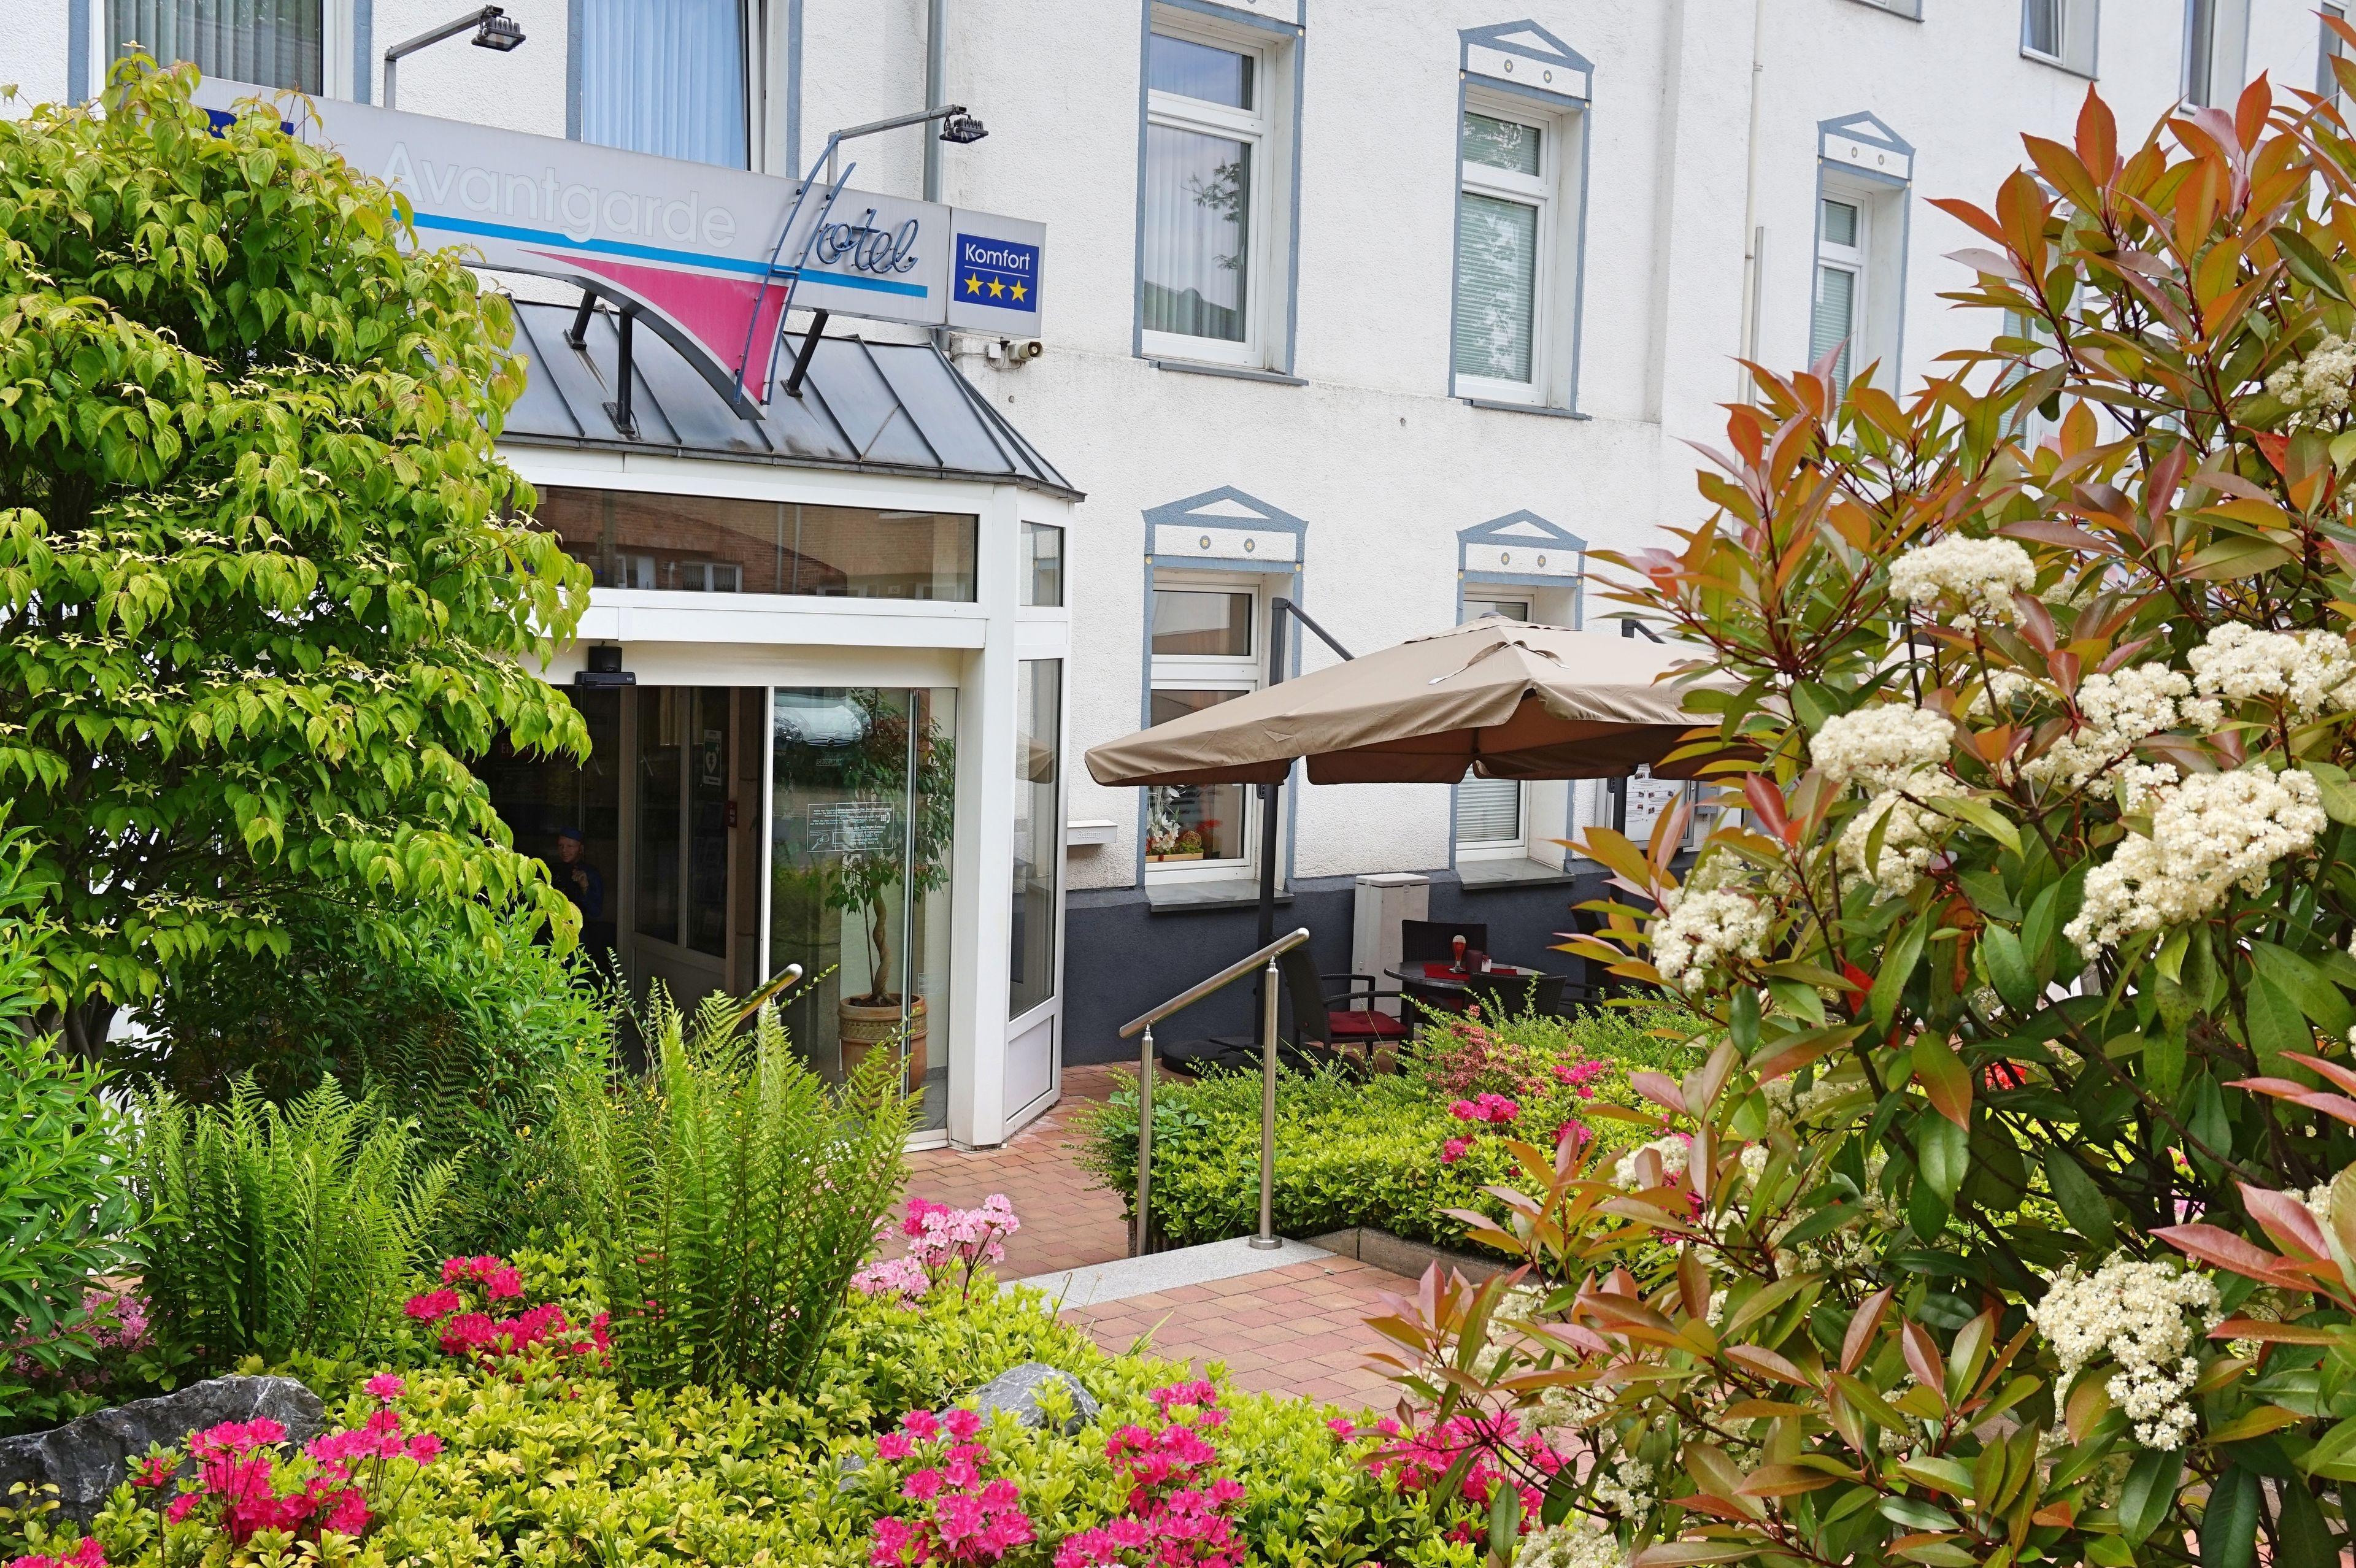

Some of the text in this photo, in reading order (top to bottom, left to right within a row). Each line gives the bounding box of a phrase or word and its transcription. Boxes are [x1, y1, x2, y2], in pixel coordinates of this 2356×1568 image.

[380, 133, 919, 405] Avantgarde Hotel
[965, 243, 1031, 271] Komfort
[1076, 829, 1102, 840] Zeitung
